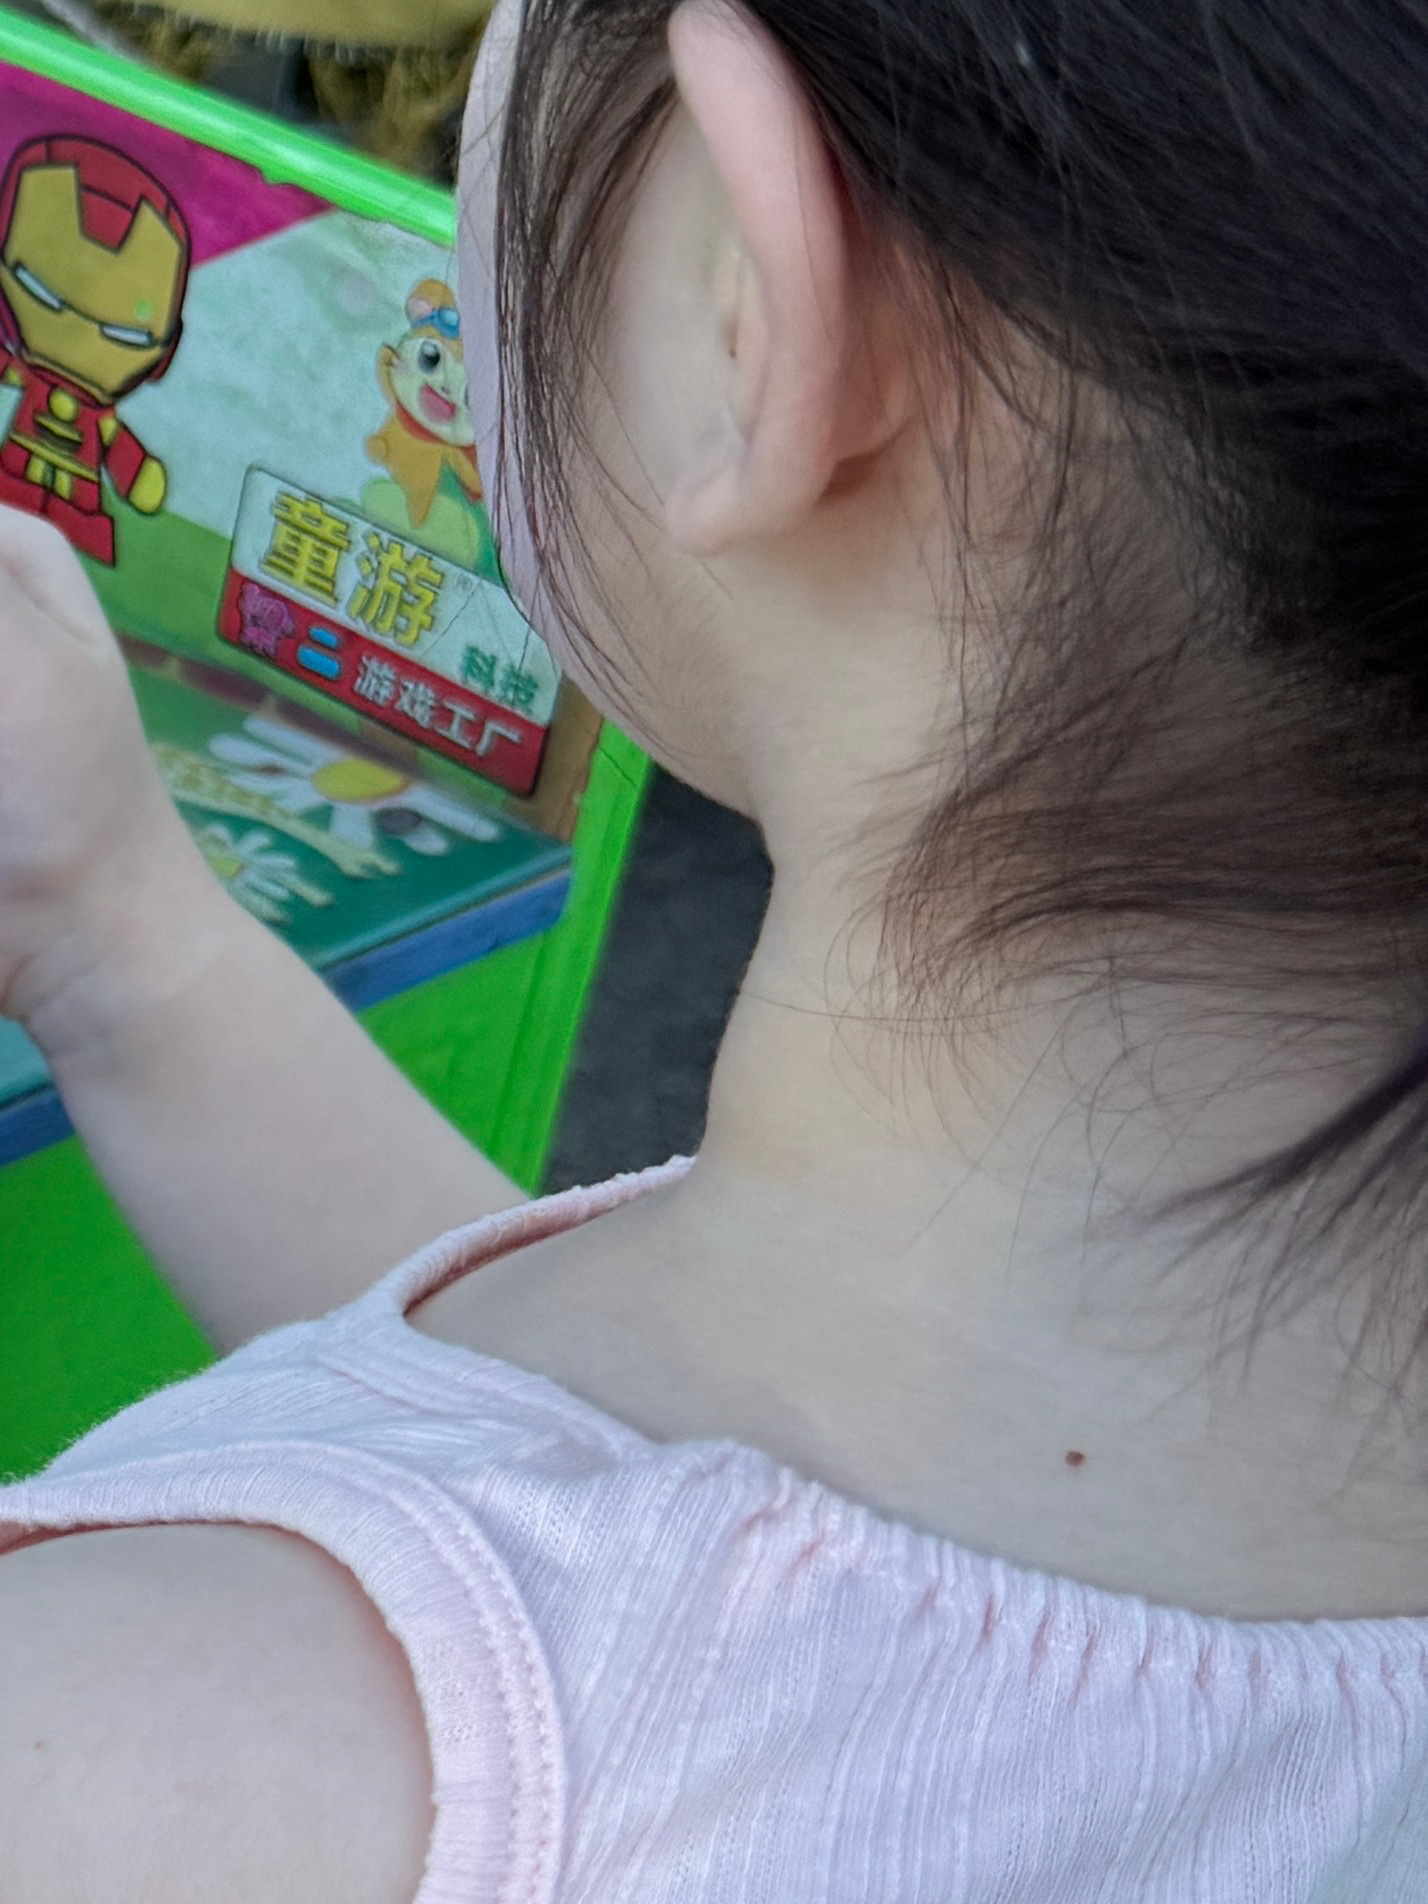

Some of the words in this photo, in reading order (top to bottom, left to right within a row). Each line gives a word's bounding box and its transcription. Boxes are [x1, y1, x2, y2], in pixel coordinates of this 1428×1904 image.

[259, 491, 444, 647] 童游
[353, 654, 523, 757] 游戏工厂
